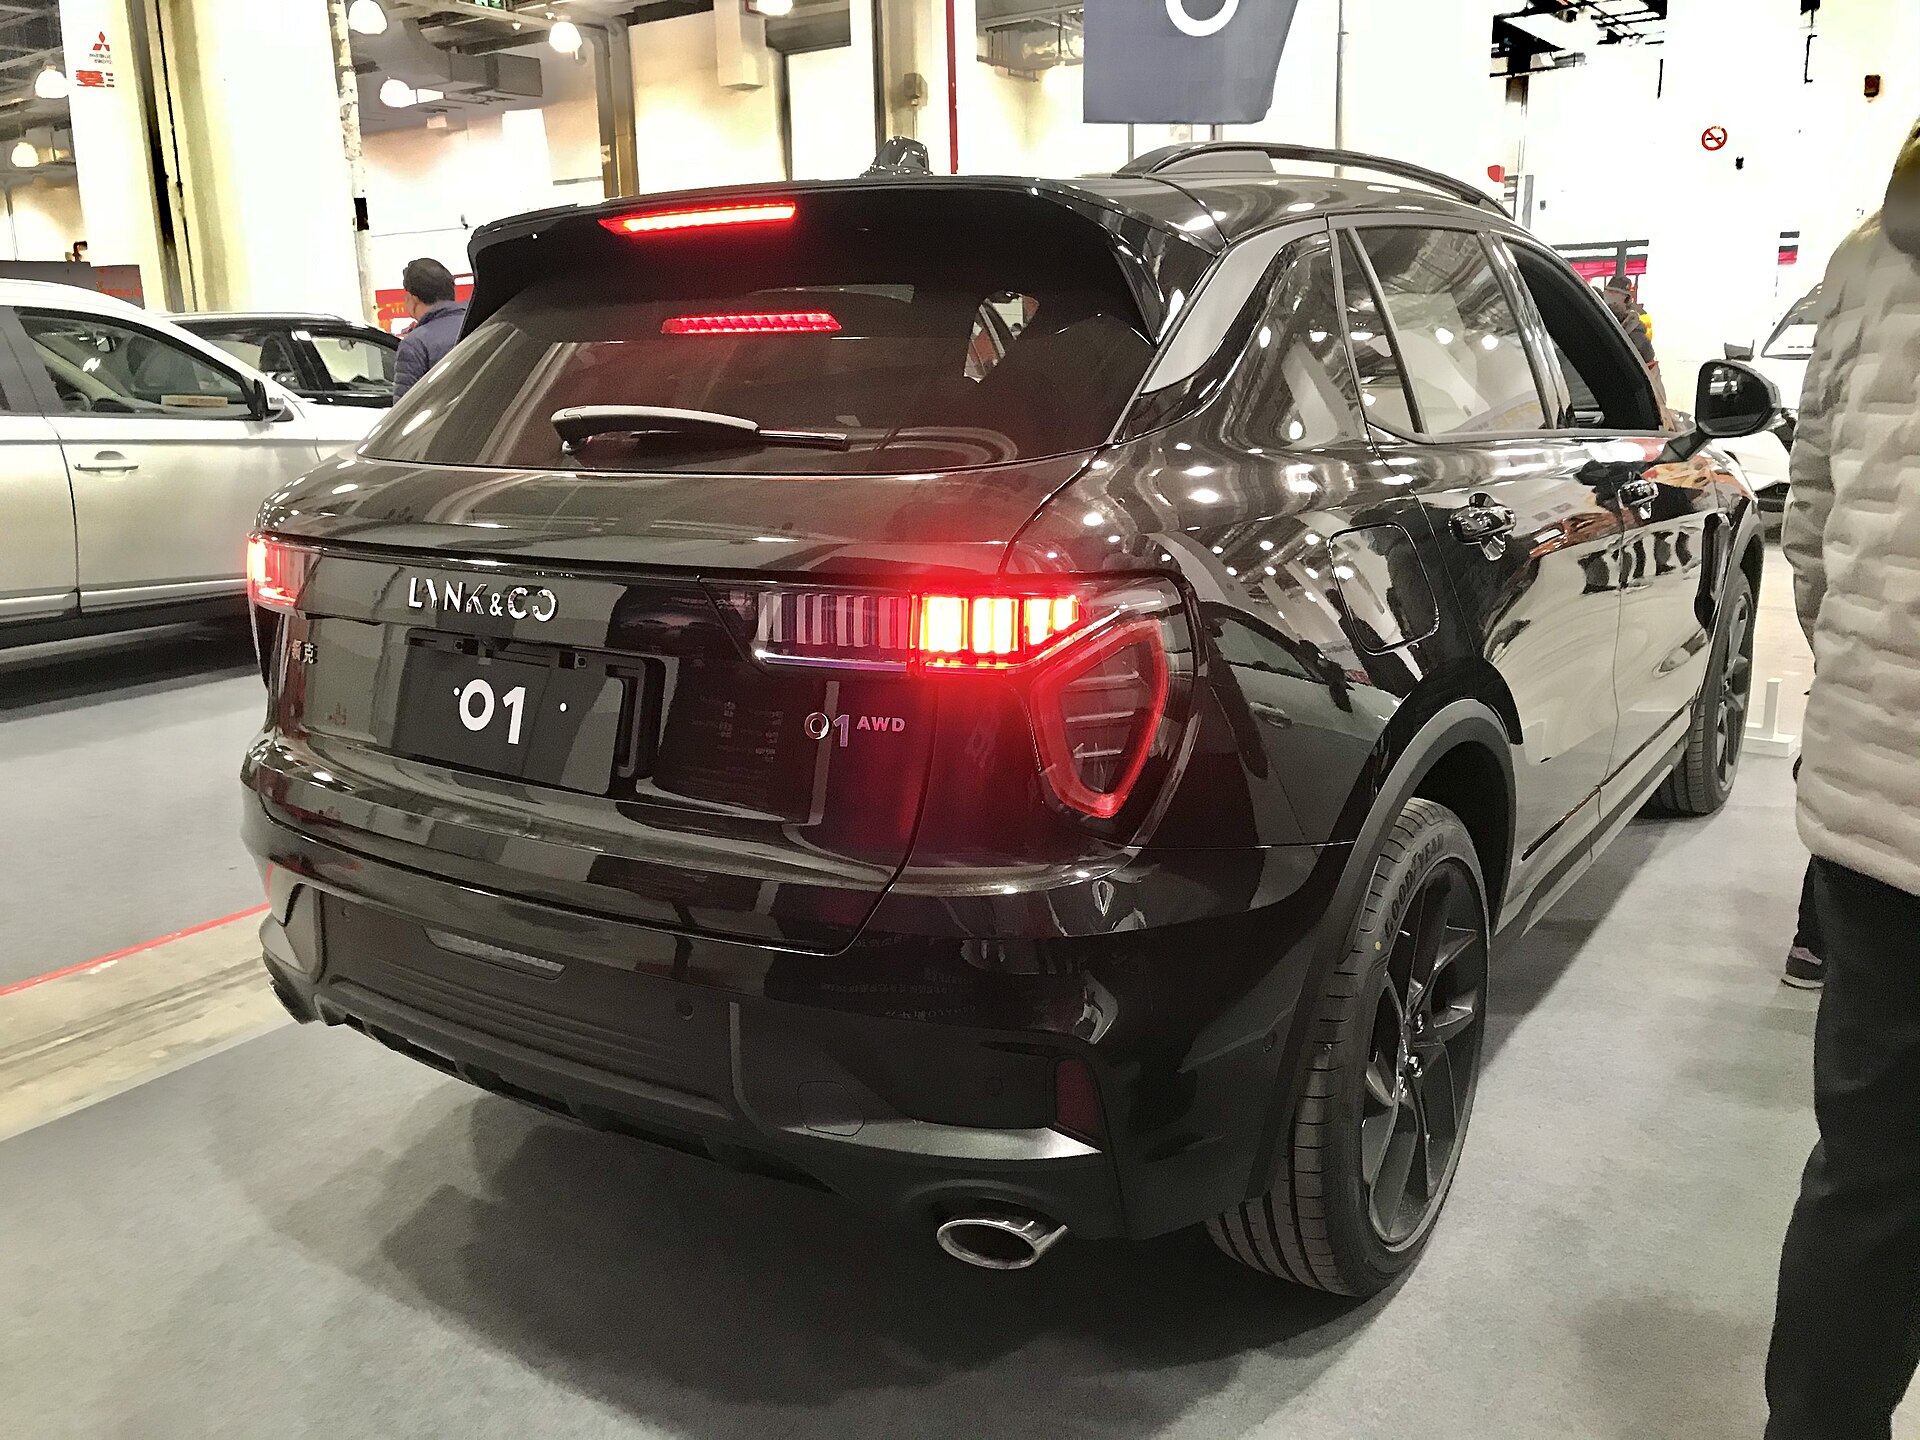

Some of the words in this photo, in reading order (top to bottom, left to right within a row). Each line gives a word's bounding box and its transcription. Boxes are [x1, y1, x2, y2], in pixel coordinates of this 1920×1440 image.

[408, 577, 556, 622] LYNK&CO
[459, 678, 526, 745] 01
[856, 715, 906, 732] AWD
